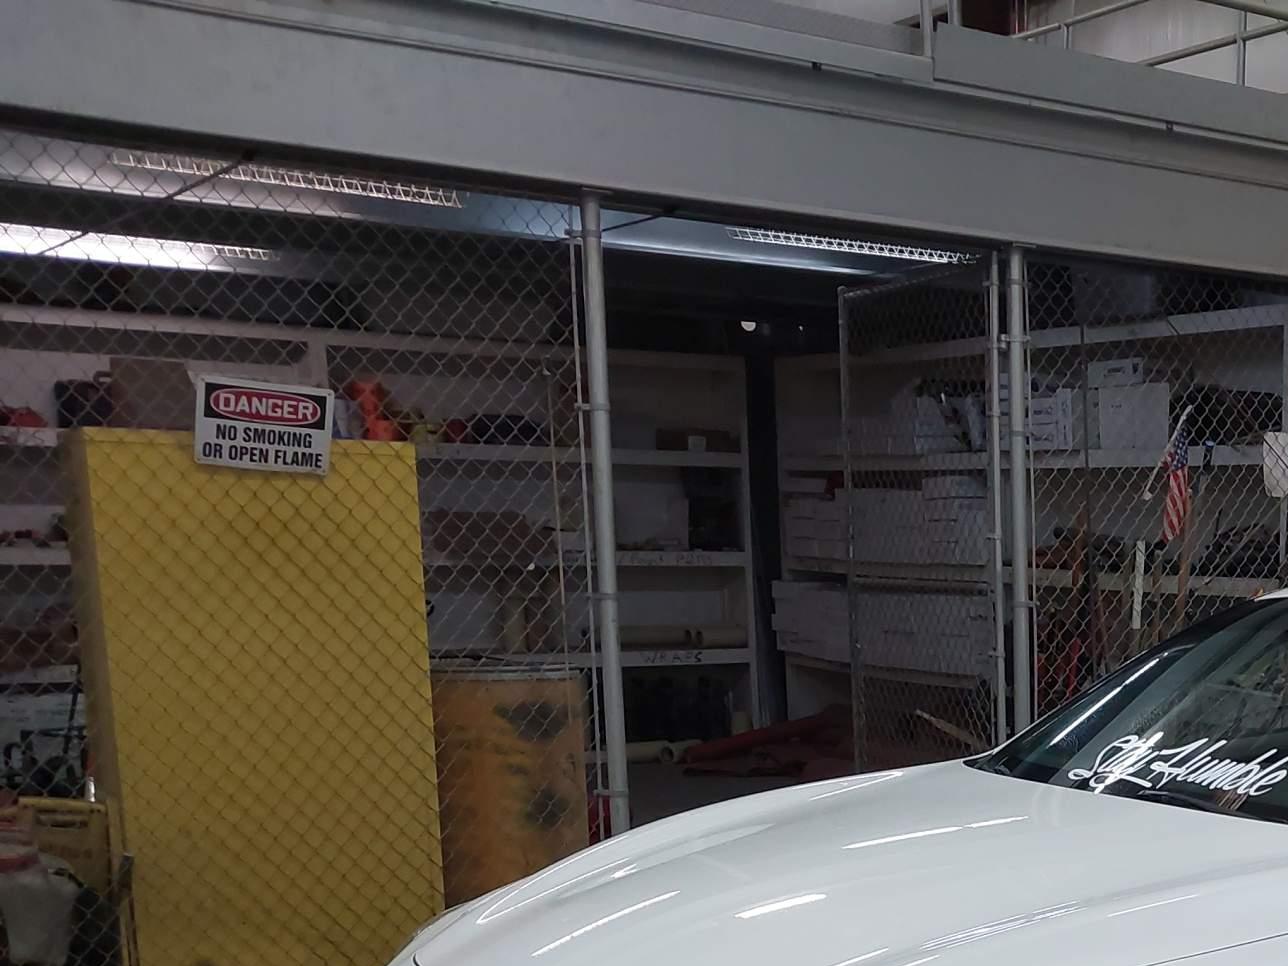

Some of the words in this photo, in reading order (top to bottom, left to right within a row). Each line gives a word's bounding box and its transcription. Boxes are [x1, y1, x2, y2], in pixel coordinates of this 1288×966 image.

[219, 393, 313, 420] DANGER
[216, 424, 237, 441] NO
[243, 427, 312, 448] SMOKING
[202, 441, 223, 459] OR
[228, 445, 269, 464] OPEN
[274, 450, 323, 469] FLAME
